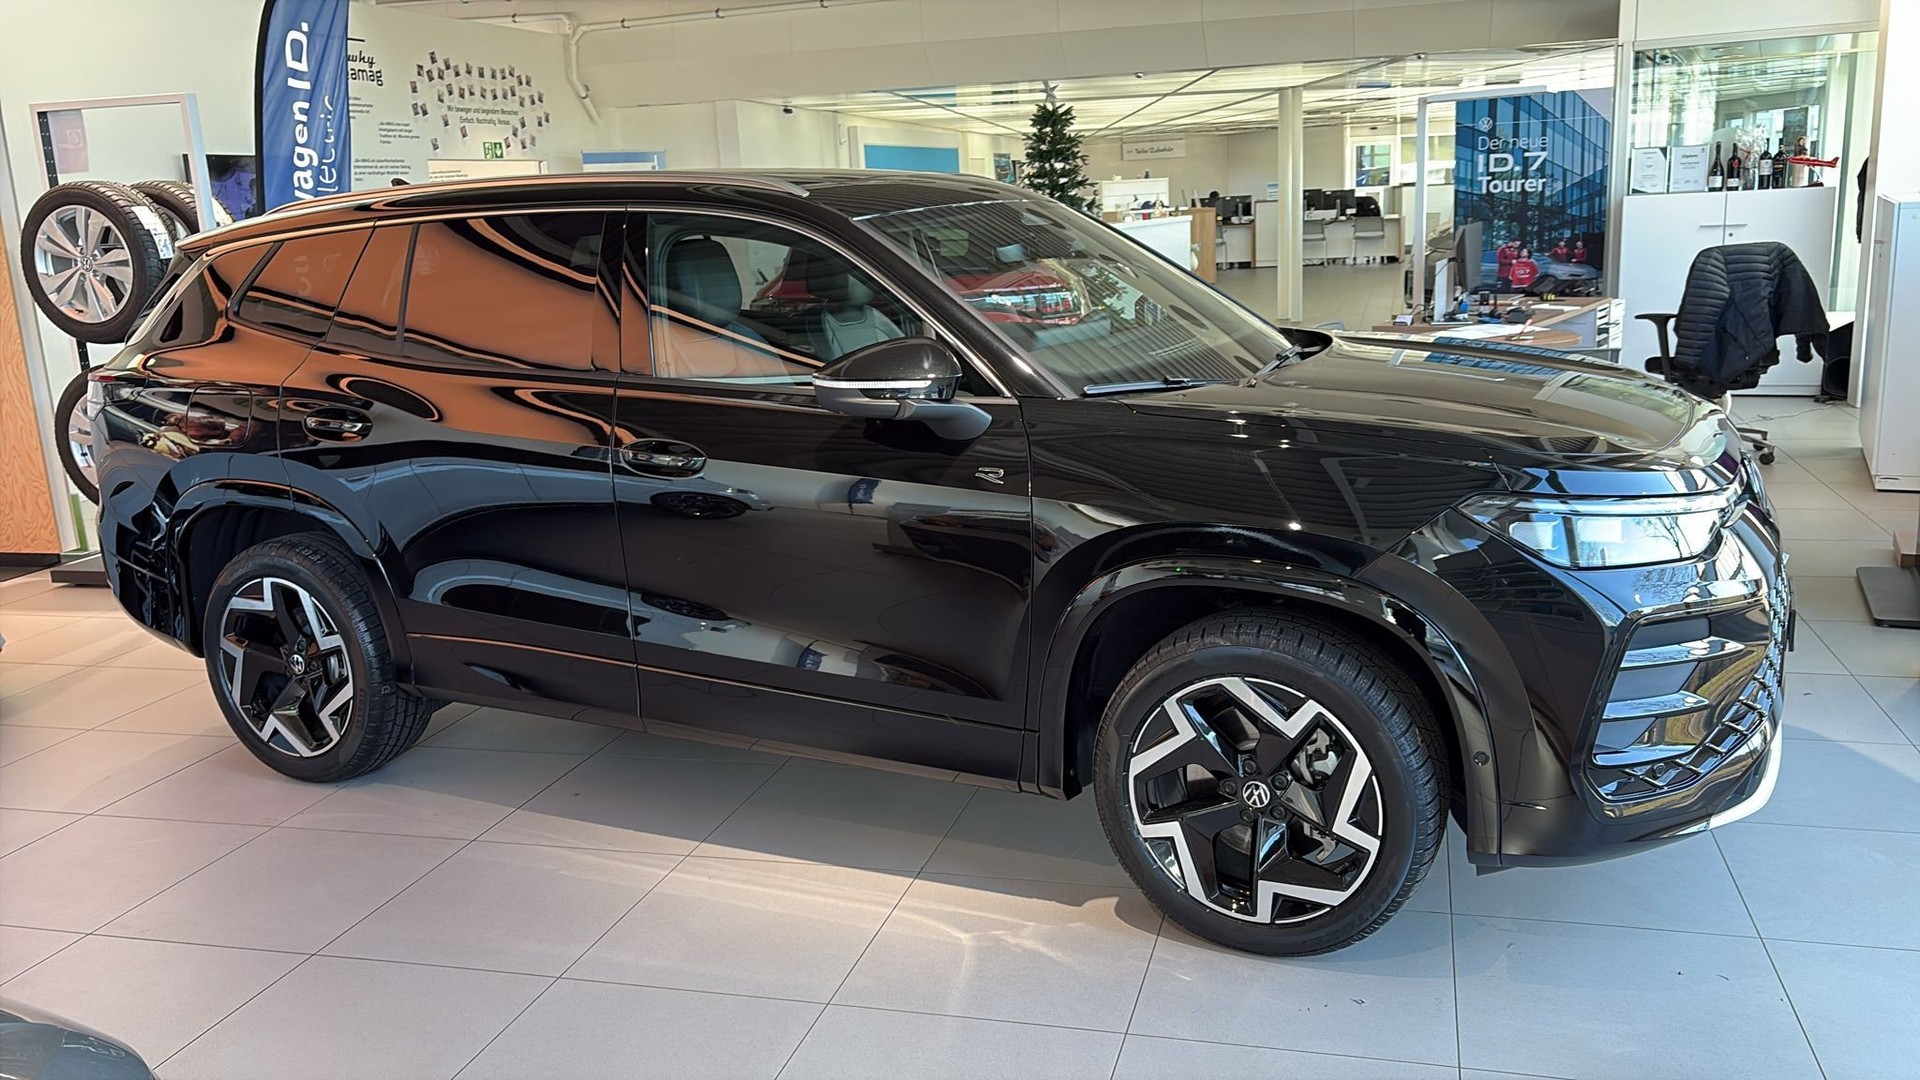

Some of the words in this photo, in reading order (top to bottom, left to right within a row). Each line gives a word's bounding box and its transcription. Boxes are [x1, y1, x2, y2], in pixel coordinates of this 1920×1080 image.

[284, 21, 311, 90] ID.
[347, 68, 384, 87] amag
[1478, 136, 1505, 150] Der
[1510, 136, 1548, 149] neue
[1477, 176, 1547, 195] Tourer
